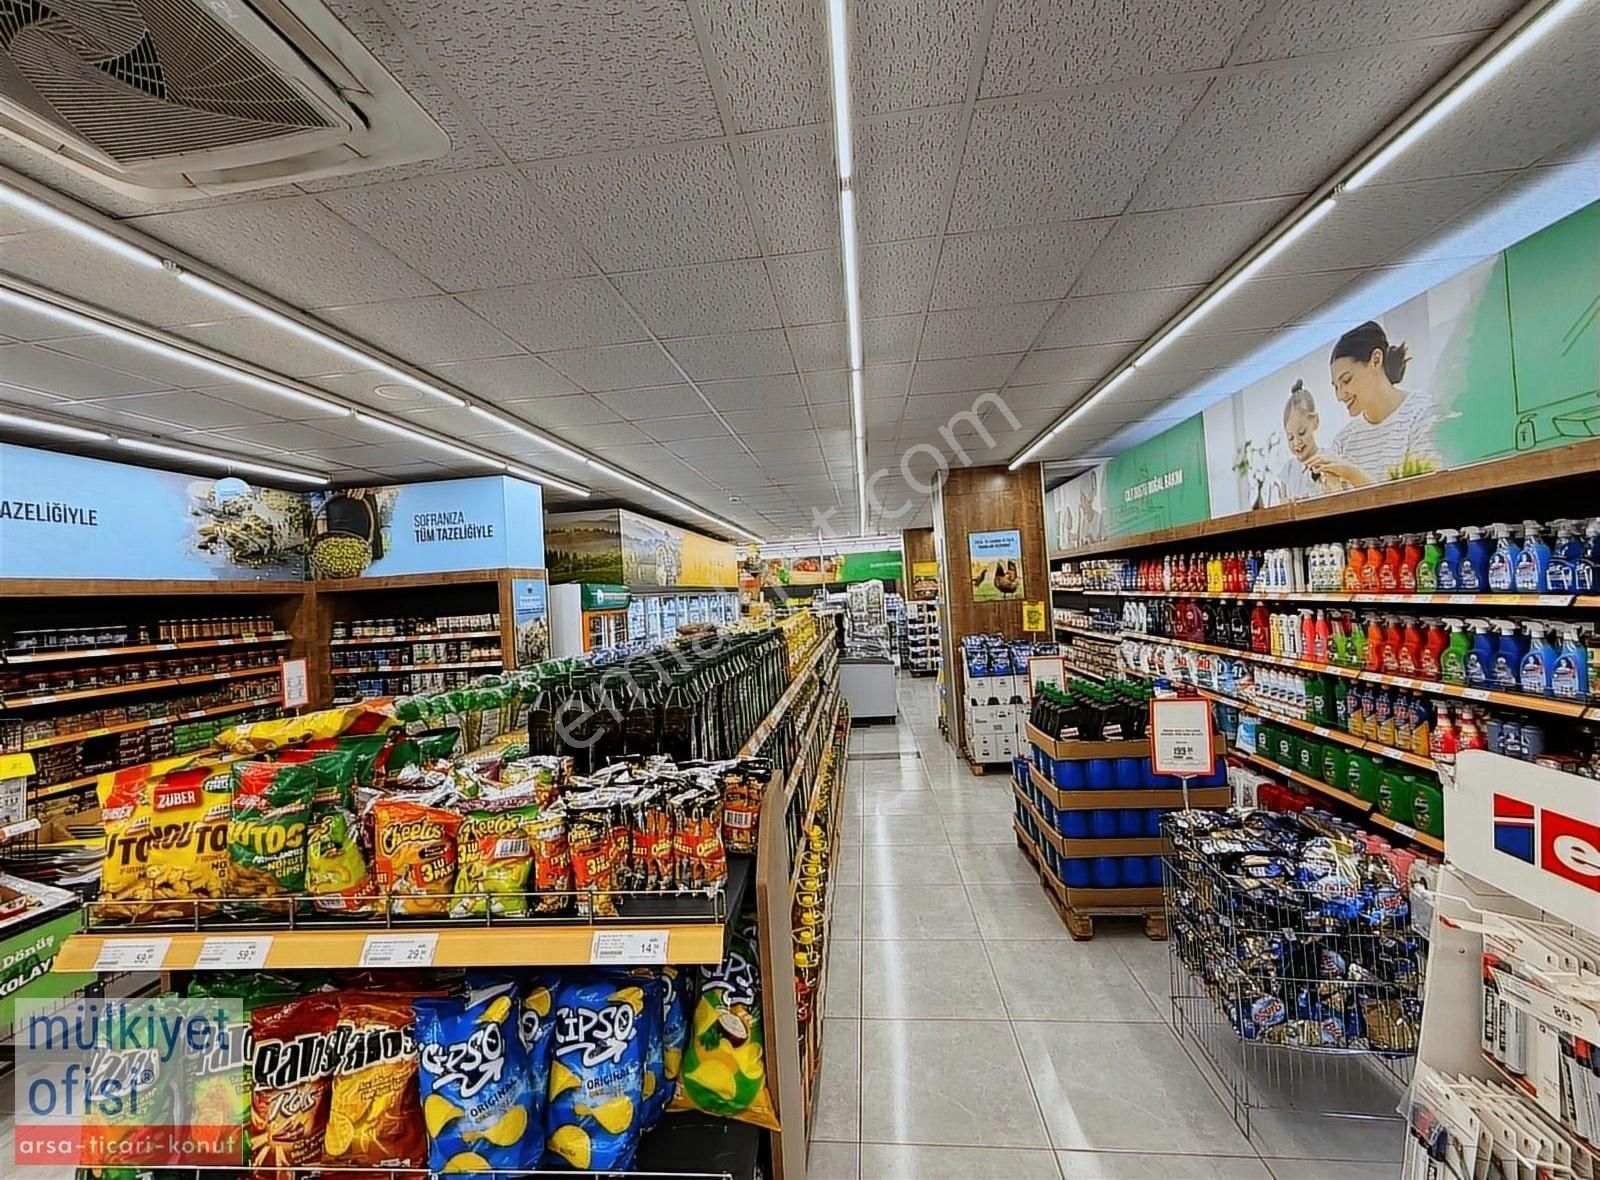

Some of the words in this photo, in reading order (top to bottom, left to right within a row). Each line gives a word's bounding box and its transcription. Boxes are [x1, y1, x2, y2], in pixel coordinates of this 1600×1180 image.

[414, 511, 464, 527] SOFRANIZA
[415, 527, 435, 542] TÜM
[436, 522, 493, 541] TAZELİĞİYLE
[3, 935, 54, 970] Dönüş
